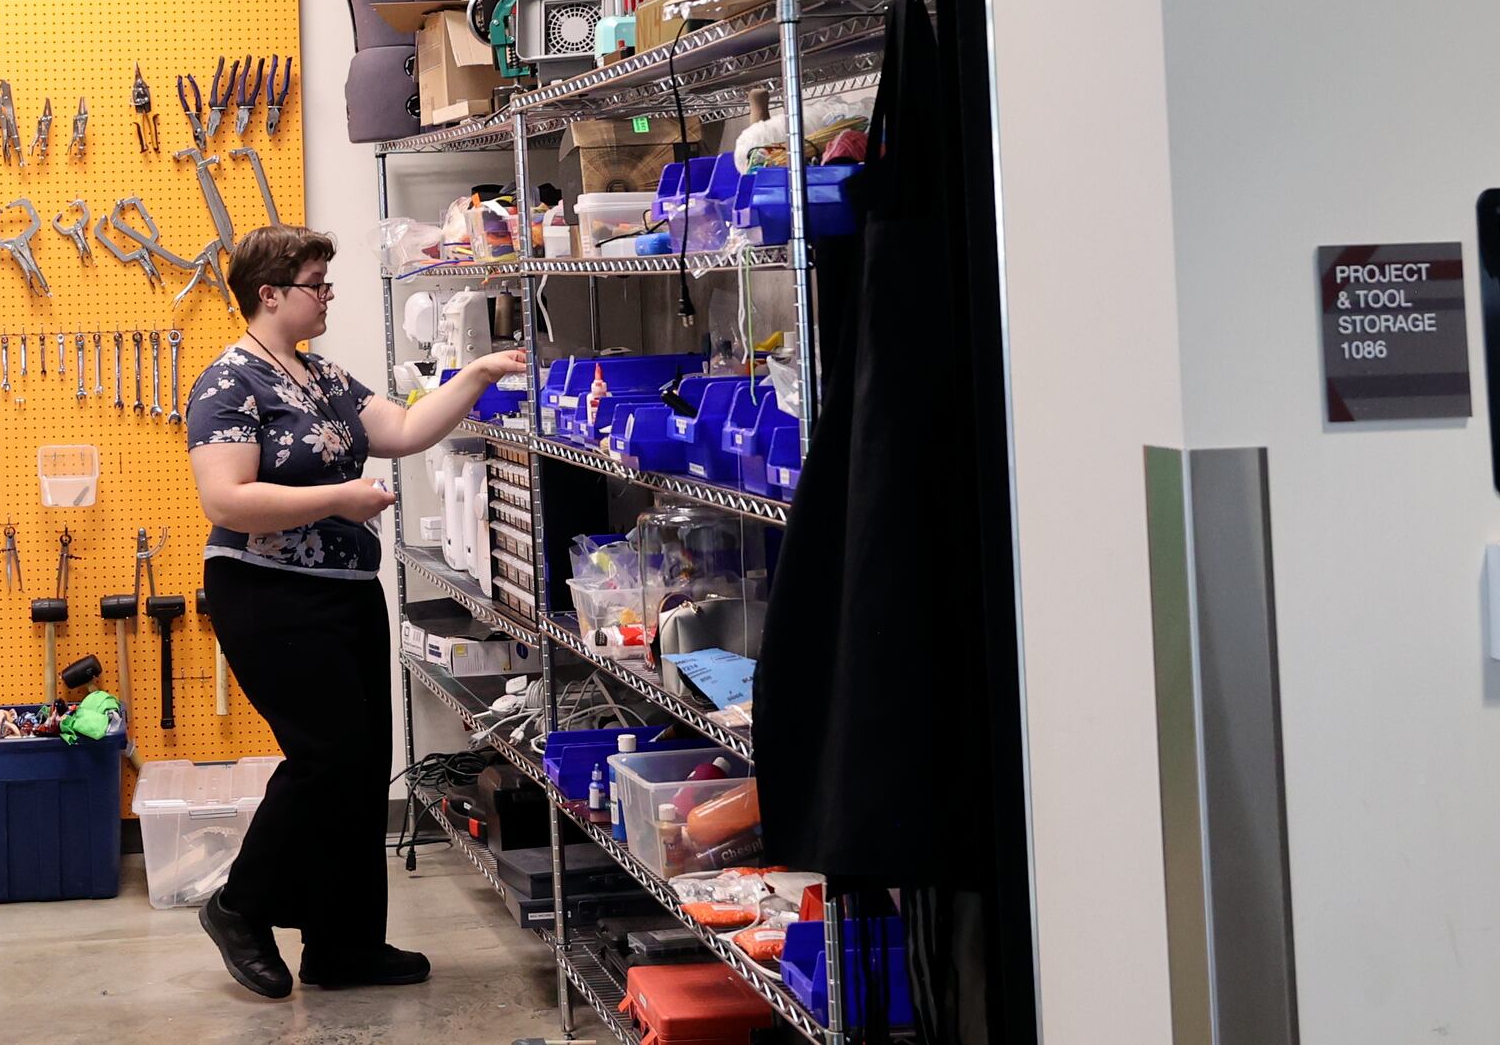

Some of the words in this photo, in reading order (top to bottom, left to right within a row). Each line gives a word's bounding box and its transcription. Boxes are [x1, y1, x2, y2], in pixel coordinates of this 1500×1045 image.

[1335, 263, 1431, 283] PROJECT
[1336, 291, 1351, 309] &
[1355, 289, 1413, 308] TOOL
[1338, 313, 1438, 334] STORAGE
[1341, 340, 1387, 359] 1086
